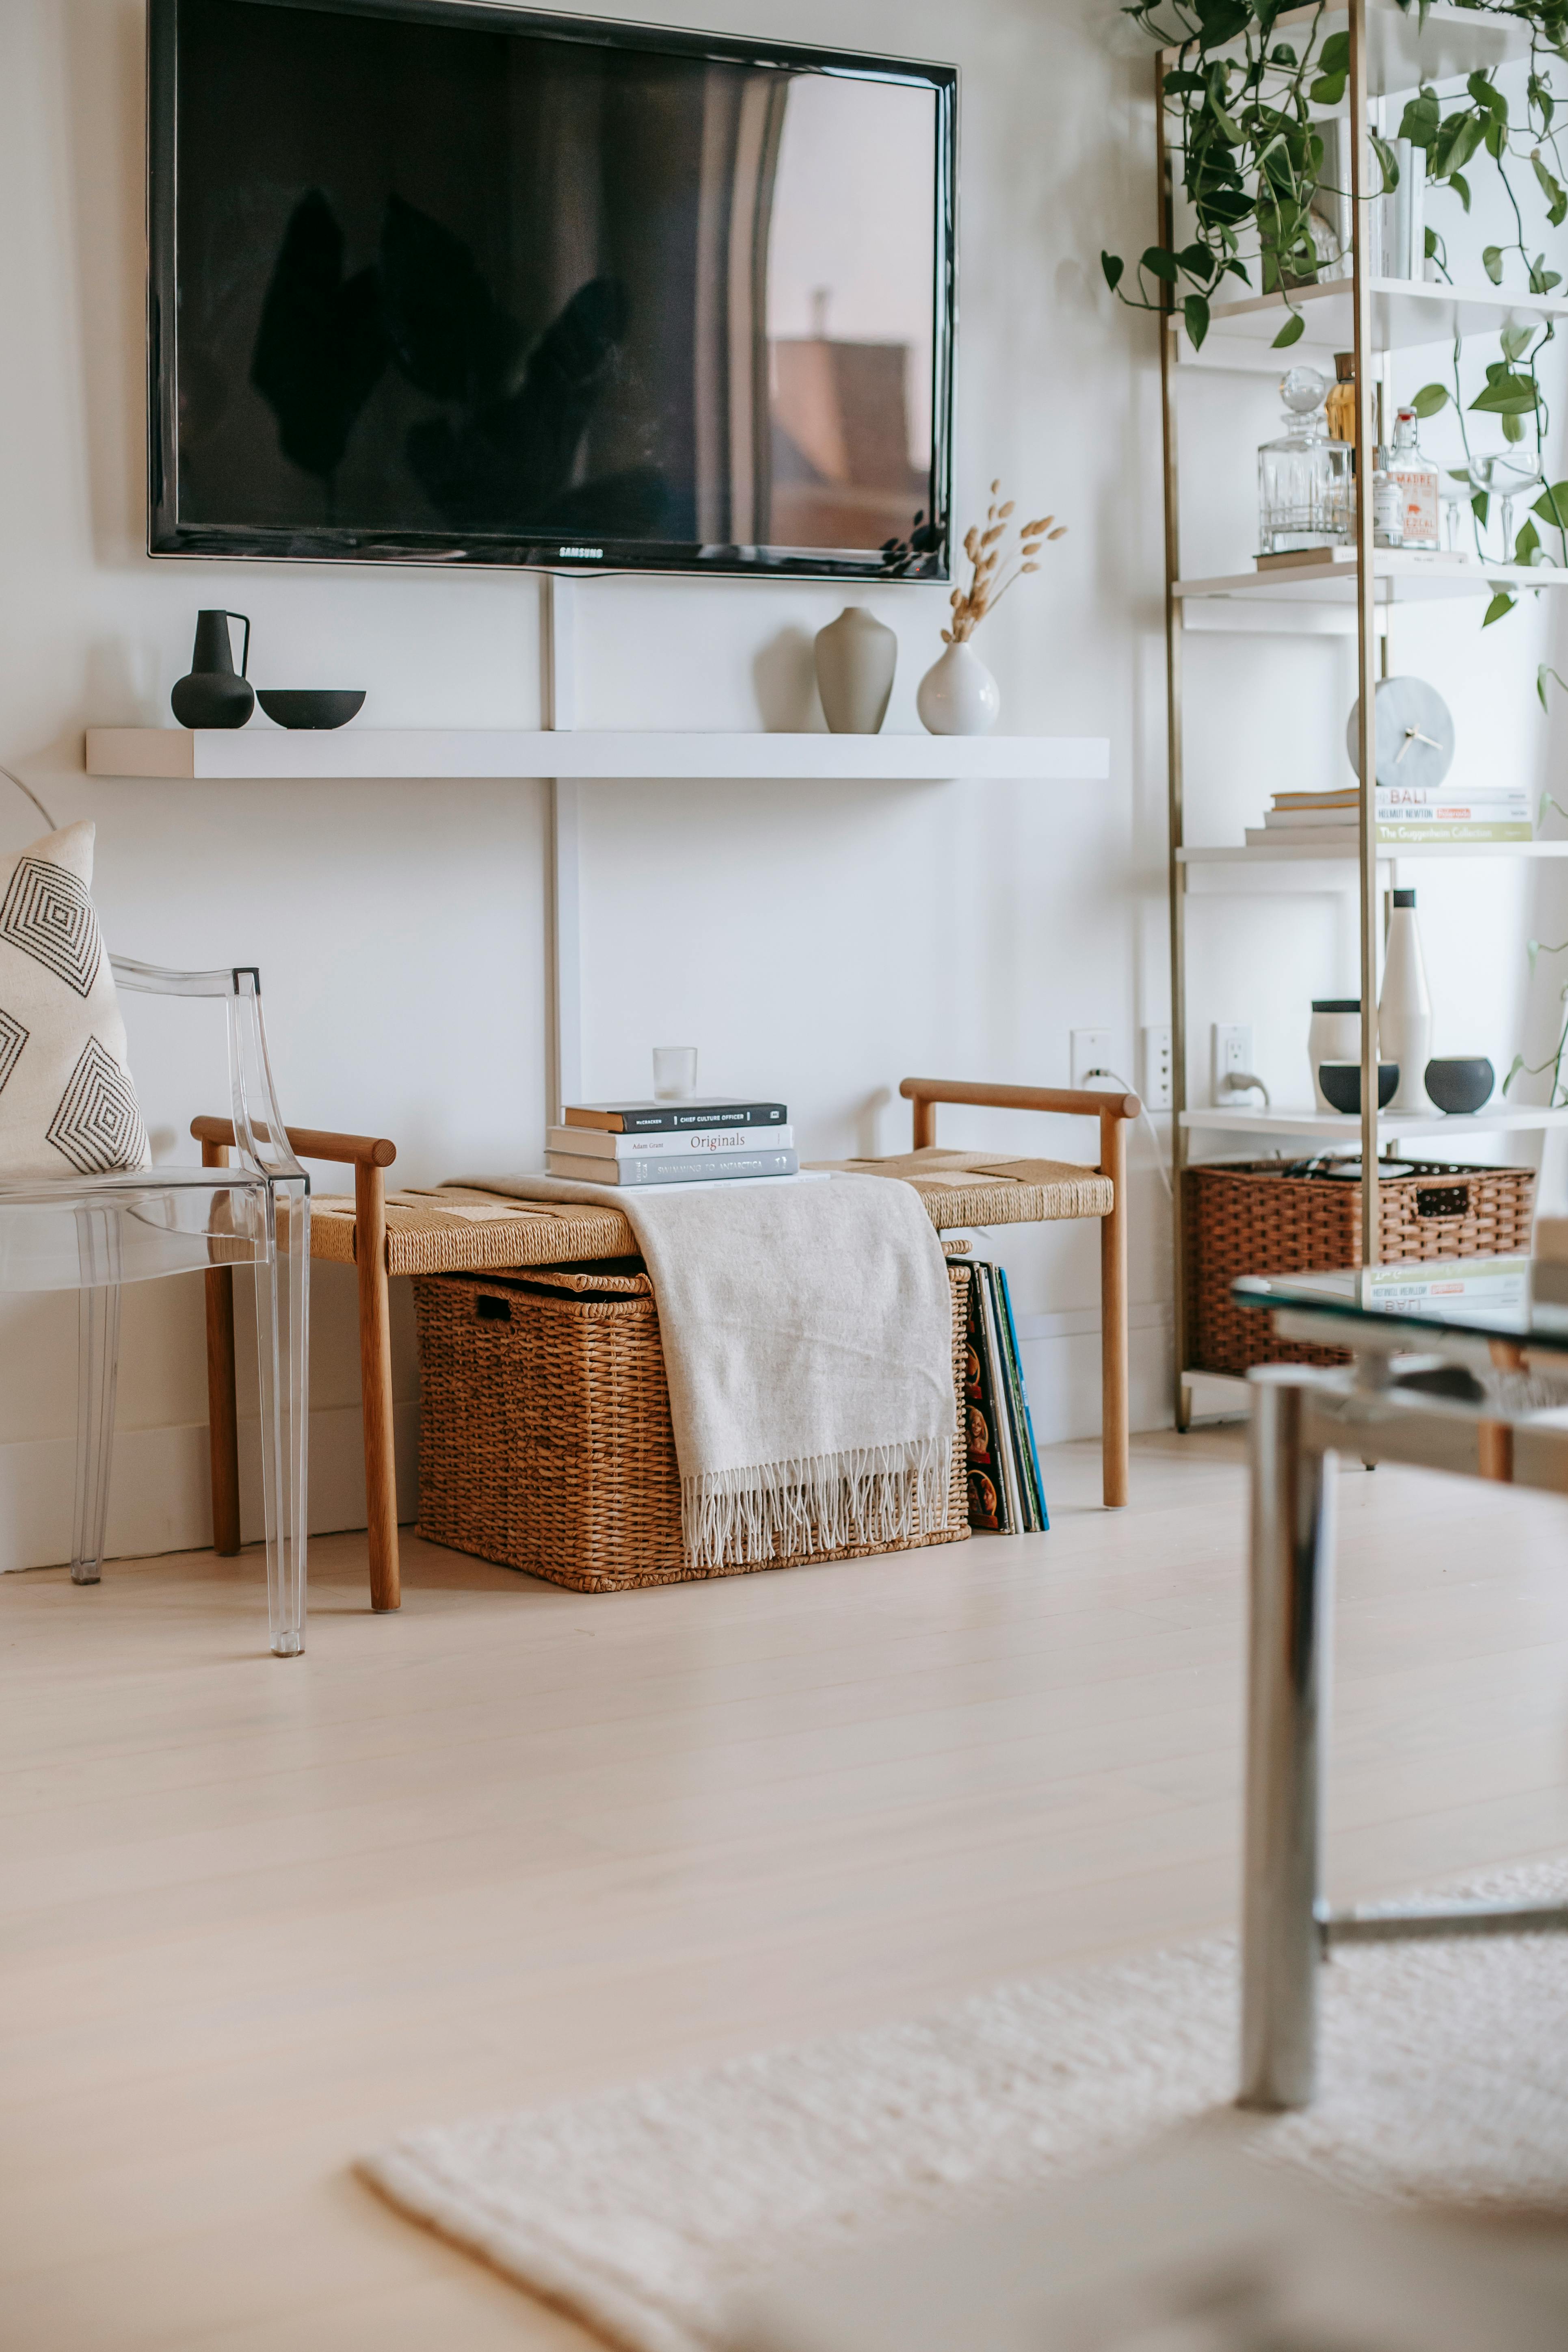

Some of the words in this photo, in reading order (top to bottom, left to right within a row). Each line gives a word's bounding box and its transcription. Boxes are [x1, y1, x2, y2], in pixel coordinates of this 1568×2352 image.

[1396, 474, 1431, 485] MADRE
[1404, 517, 1433, 528] EZCAL
[559, 547, 603, 558] SAMSUNG
[1390, 789, 1427, 804] BALI
[1379, 808, 1404, 818] HELMUT
[1406, 808, 1433, 818] NEWTON
[1380, 826, 1396, 839] The
[1398, 826, 1450, 841] Guggenheim
[1451, 826, 1492, 837] Collection
[691, 1132, 745, 1151] Originals
[657, 1164, 701, 1175] SWIMMING
[720, 1161, 763, 1171] ANTARCTICA
